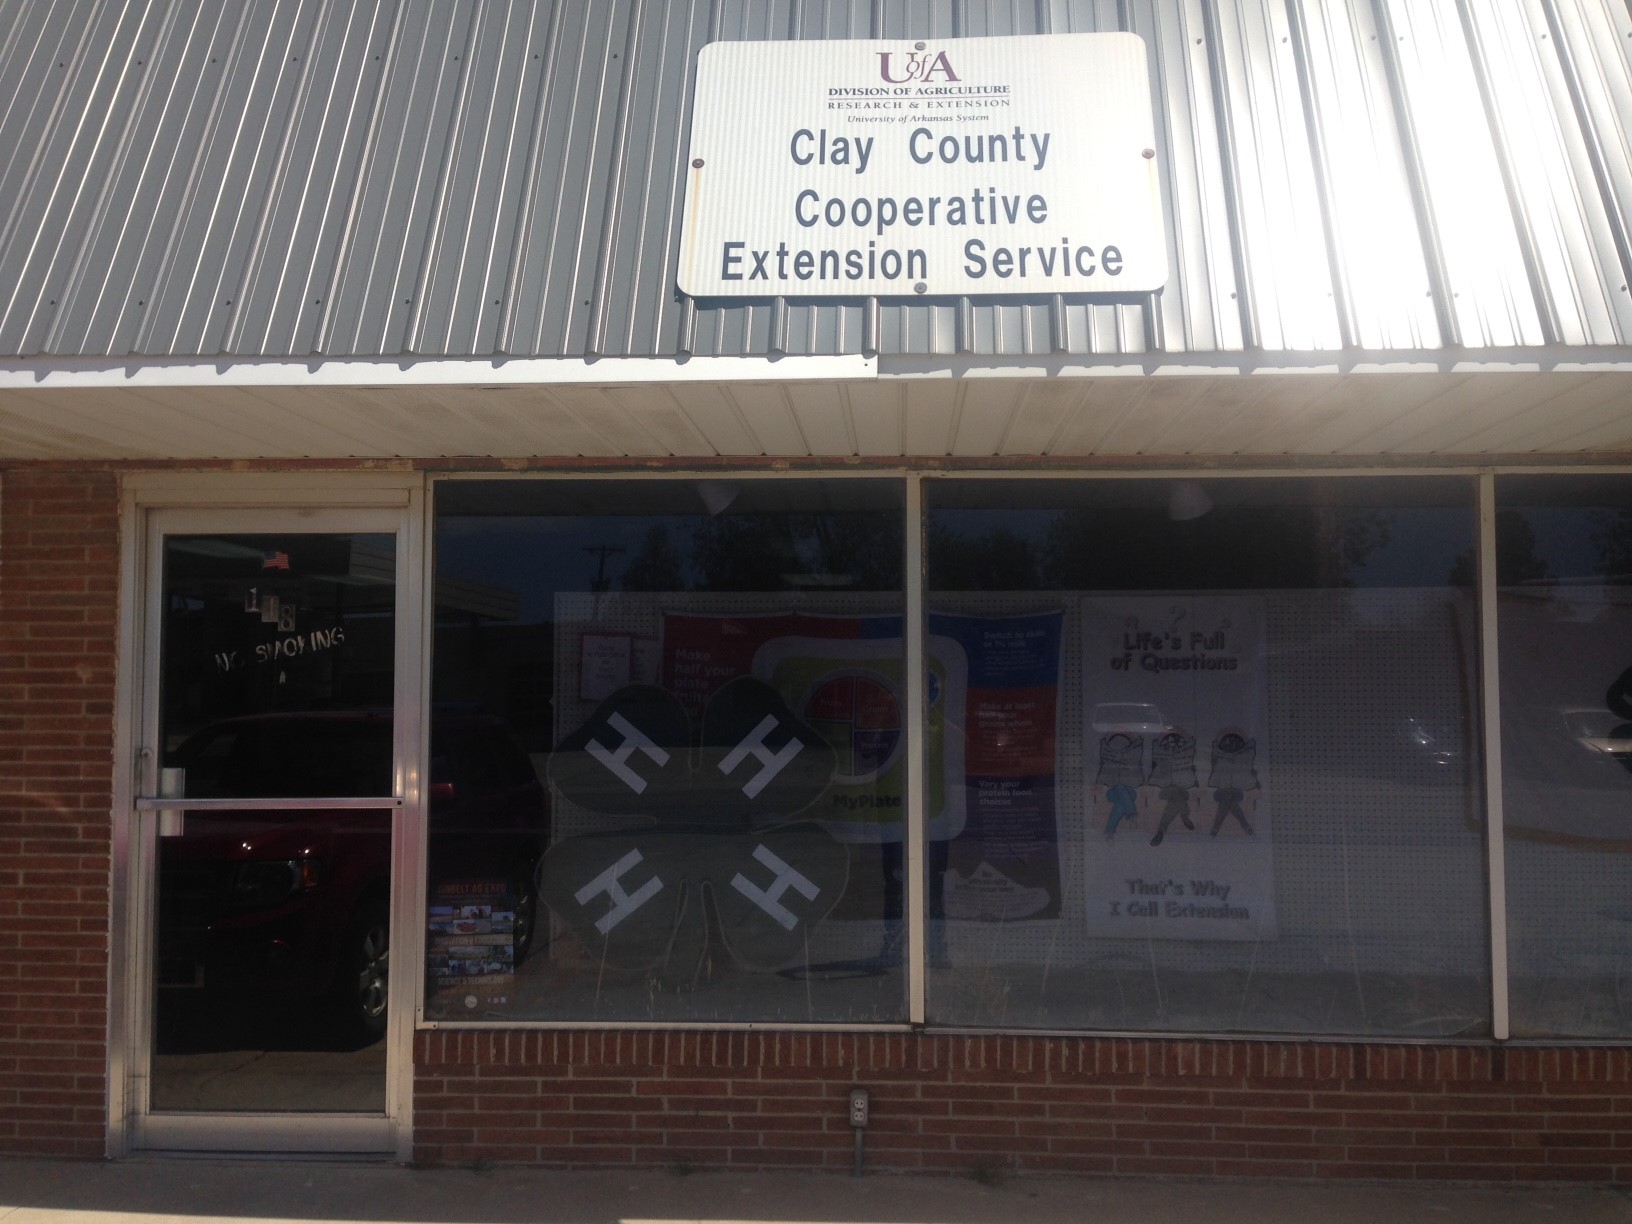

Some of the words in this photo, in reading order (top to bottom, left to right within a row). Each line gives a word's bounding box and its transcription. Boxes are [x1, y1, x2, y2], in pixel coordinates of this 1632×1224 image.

[828, 86, 889, 97] DIVISION
[893, 86, 912, 96] OF
[914, 84, 1011, 96] AGRICULTURE
[828, 100, 903, 110] RESEARCH
[909, 101, 920, 109] &
[927, 99, 1011, 109] EXTENSION
[847, 114, 896, 124] University
[898, 113, 908, 124] of
[909, 113, 954, 122] Arkansas
[955, 112, 989, 123] System
[790, 128, 874, 174] Clay
[909, 125, 1051, 171] County
[795, 187, 1048, 235] Cooperative
[721, 240, 928, 281] Extension
[963, 237, 1124, 279] Service
[983, 631, 1013, 640] Switch
[1123, 632, 1182, 651] Life's
[1189, 632, 1225, 651] Full
[675, 649, 711, 661] Make
[1110, 654, 1132, 670] of
[1141, 654, 1238, 673] Questions
[674, 662, 701, 674] half
[704, 666, 737, 678] your
[673, 676, 709, 689] plate
[583, 710, 670, 795] H
[717, 712, 805, 800] H
[833, 793, 902, 811] MyPlate
[979, 798, 1012, 806] choices
[573, 847, 665, 936] H
[730, 842, 821, 931] H
[1125, 878, 1185, 896] That's
[1191, 880, 1231, 901] Why
[1165, 902, 1250, 919] Extension
